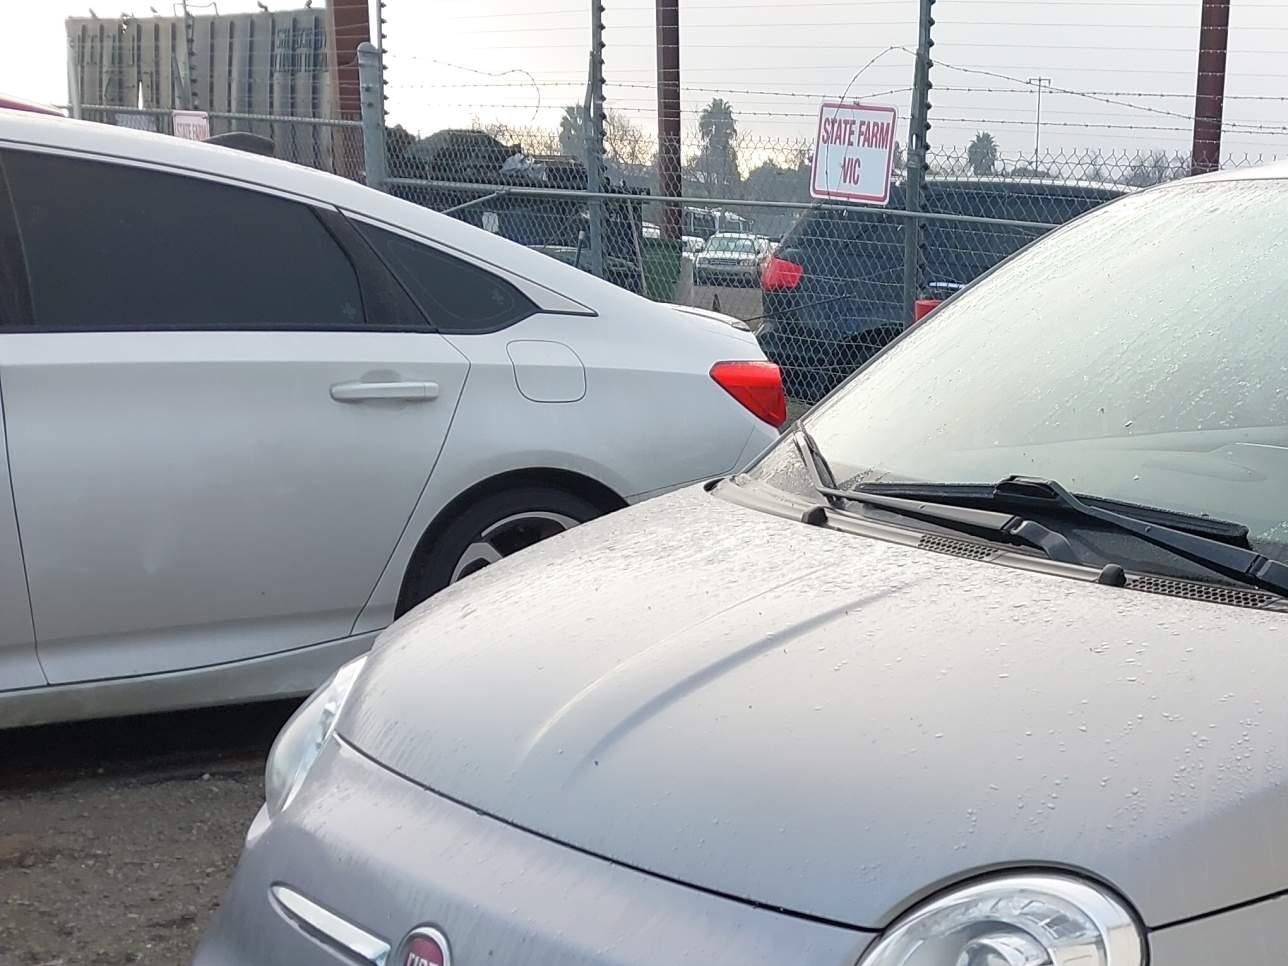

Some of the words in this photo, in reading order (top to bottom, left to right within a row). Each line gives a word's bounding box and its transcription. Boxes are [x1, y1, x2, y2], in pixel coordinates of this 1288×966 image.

[822, 117, 856, 147] STATE
[857, 120, 891, 150] FARM
[843, 156, 861, 185] VIC
